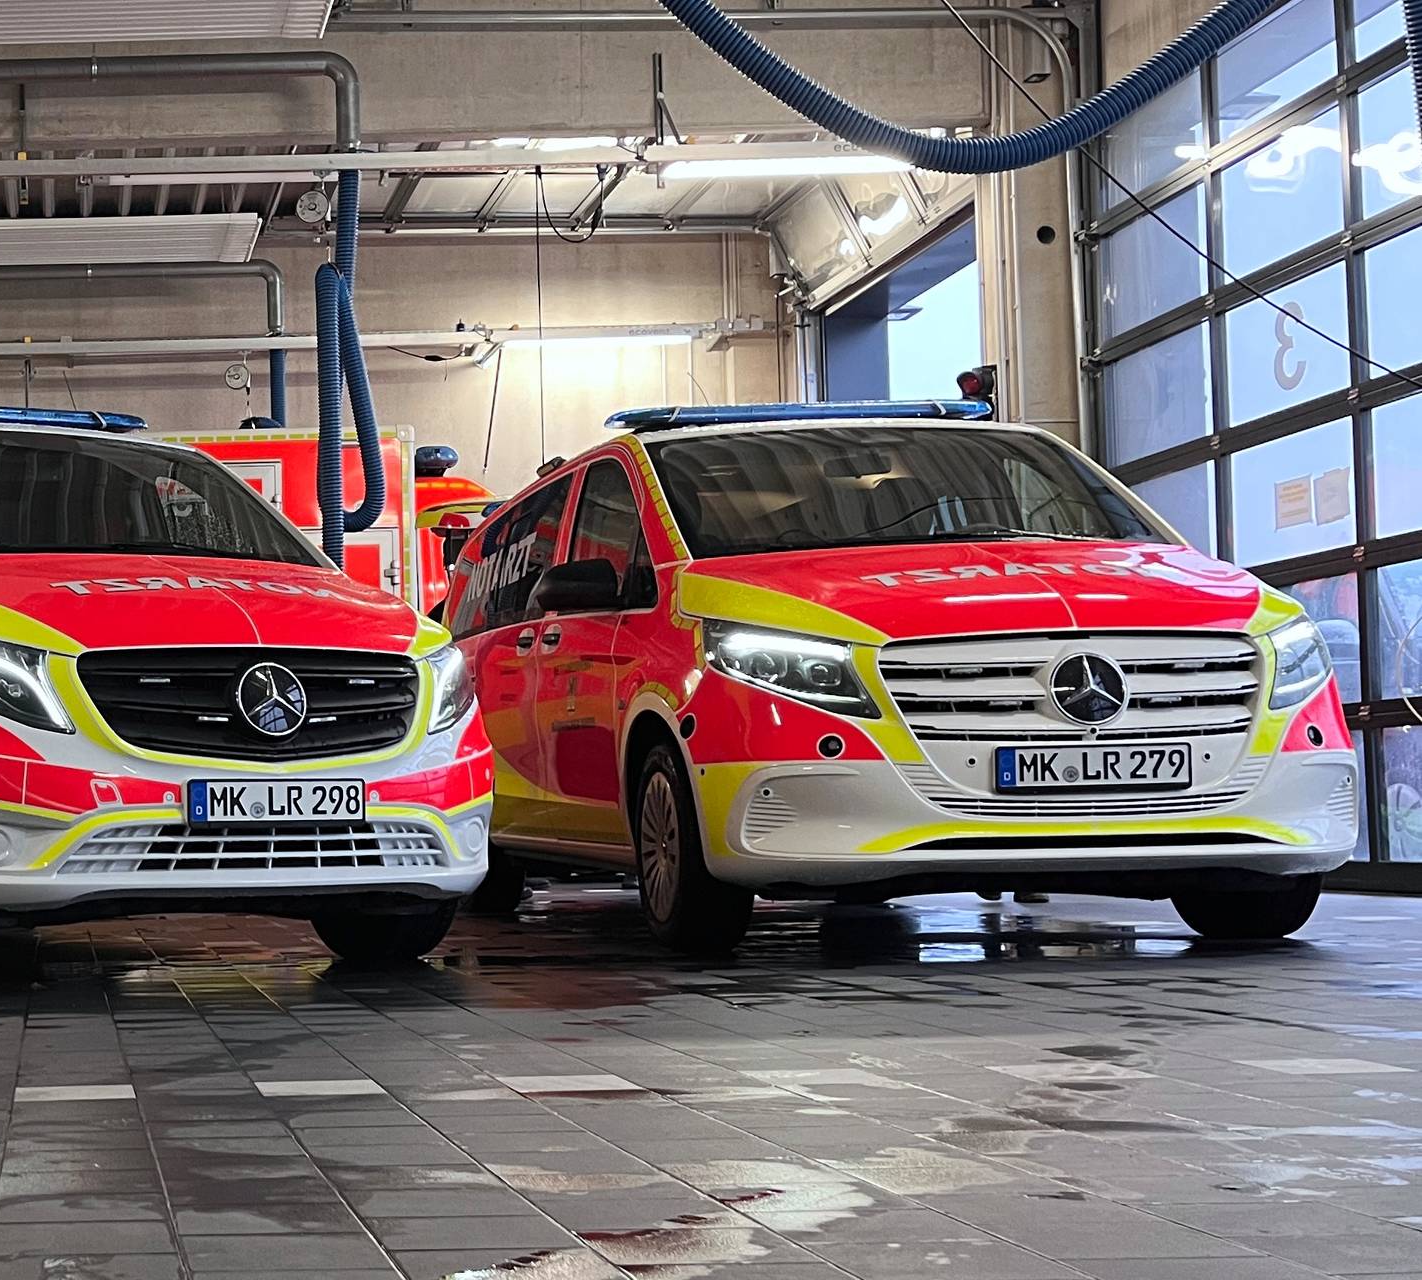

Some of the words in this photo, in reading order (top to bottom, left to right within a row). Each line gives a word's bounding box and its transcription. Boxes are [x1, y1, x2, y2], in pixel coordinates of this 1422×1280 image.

[467, 531, 538, 603] NOTARZT
[1003, 772, 1012, 781] D
[1018, 752, 1060, 782] MK
[1081, 751, 1122, 780] LR
[1129, 749, 1186, 779] 279
[195, 805, 203, 815] D
[209, 786, 248, 817] MK
[267, 786, 304, 816] LR
[311, 785, 361, 815] 298
